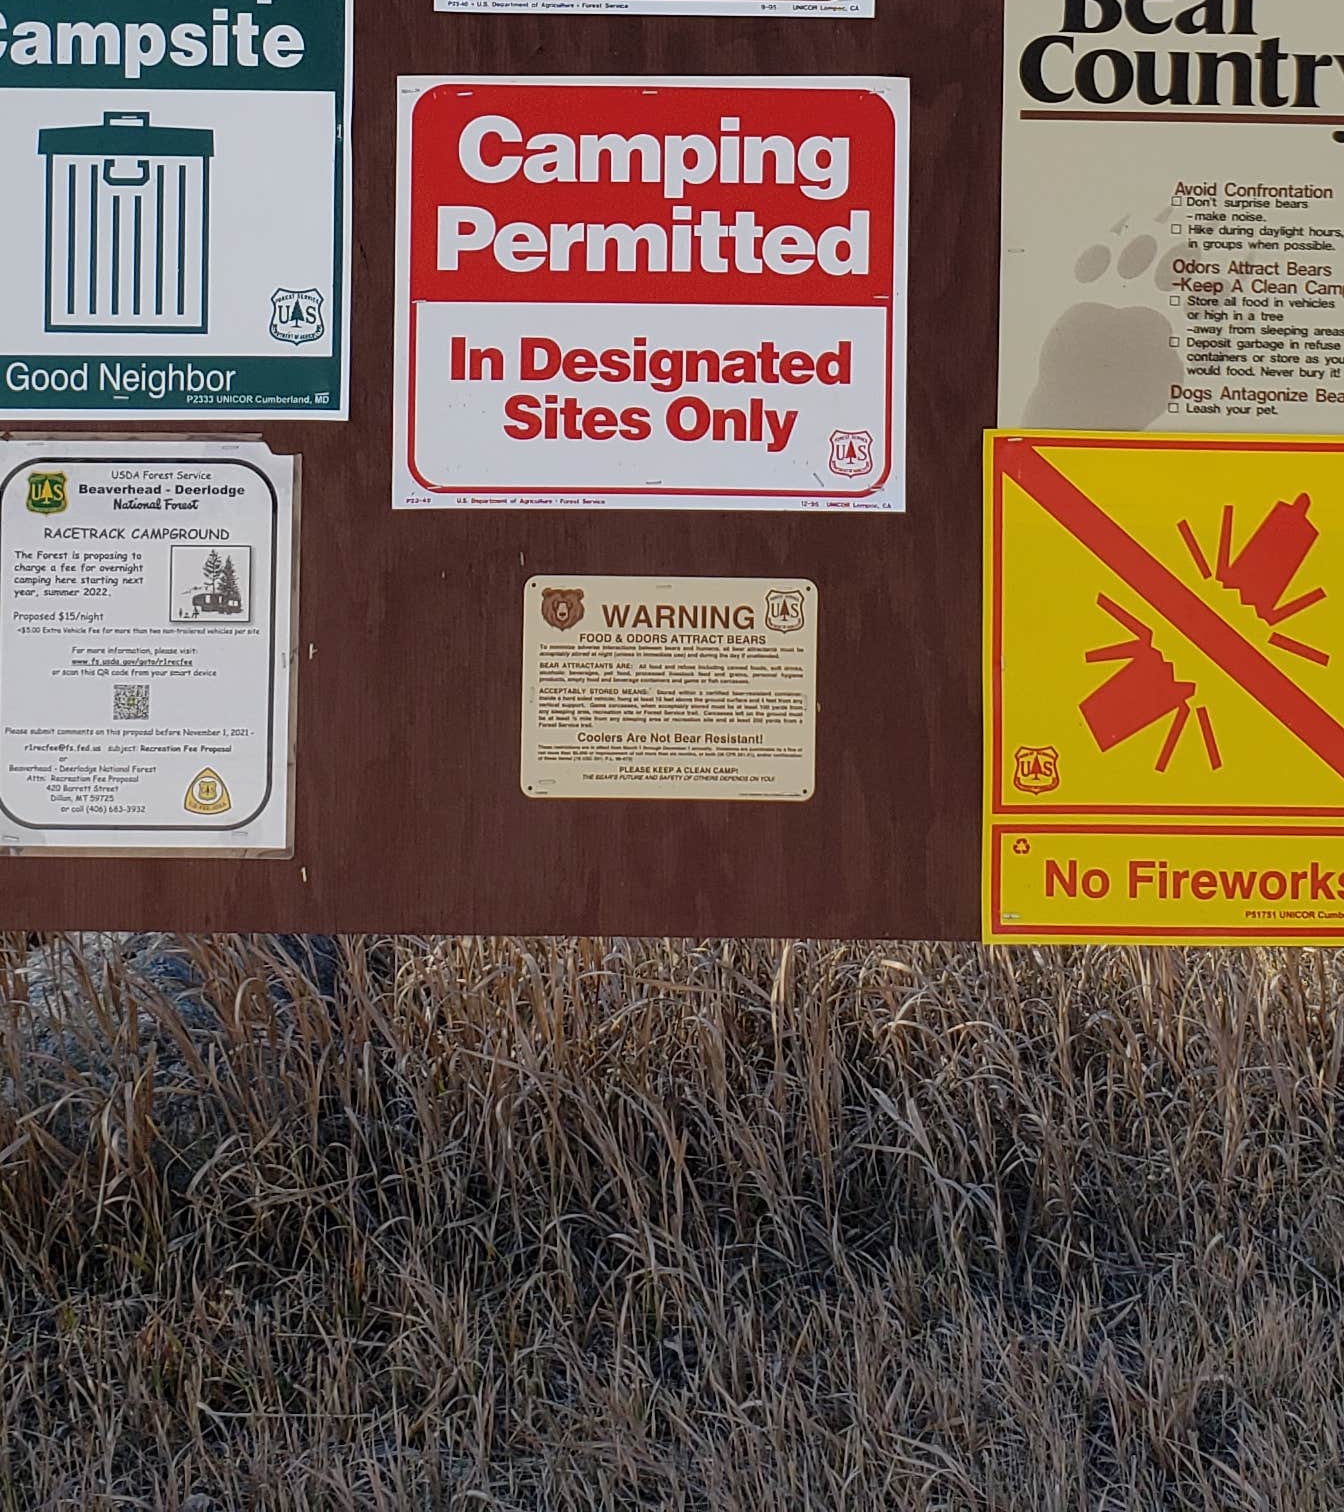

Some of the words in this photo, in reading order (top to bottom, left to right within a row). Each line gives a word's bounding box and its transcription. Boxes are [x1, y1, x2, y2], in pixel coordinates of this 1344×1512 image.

[459, 115, 849, 200] Camping
[1175, 182, 1216, 196] Avoid
[1225, 183, 1333, 198] Confrontation
[437, 206, 869, 275] Permitted
[1173, 259, 1220, 274] Odors
[1228, 261, 1279, 275] Attract
[1287, 262, 1332, 276] Bears
[1230, 278, 1244, 293] A
[1252, 279, 1297, 294] Clean
[451, 337, 503, 380] In
[521, 337, 851, 392] Designated
[6, 362, 87, 391] Good
[100, 363, 236, 402] Neighbor
[216, 394, 254, 404] UNICOR
[314, 394, 330, 404] MD
[1171, 385, 1212, 403] Dogs
[1220, 386, 1308, 404] Antagonize
[504, 395, 651, 440] Sites
[666, 396, 798, 452] Only
[111, 470, 140, 480] USDA
[142, 470, 174, 480] Forest
[176, 470, 212, 481] Service
[78, 483, 162, 495] Beaverhead
[174, 484, 245, 498] Deerlodge
[113, 497, 162, 511] National
[163, 497, 200, 511] Forest
[43, 526, 126, 540] RACETRACK
[131, 527, 230, 541] CAMPGROUND
[13, 611, 56, 623] Proposed
[58, 611, 104, 624] $15/night
[602, 605, 754, 629] WARNING
[579, 632, 612, 643] FOOD
[615, 633, 623, 644] &
[626, 633, 668, 644] ODORS
[670, 634, 725, 645] ATTRACT
[726, 634, 767, 645] BEARS
[577, 731, 623, 743] Coolers
[626, 732, 647, 743] Are
[650, 732, 671, 744] Not
[674, 732, 702, 744] Bear
[704, 733, 764, 745] Resistant!
[1046, 860, 1109, 898] No
[1279, 910, 1316, 920] UNICOR
